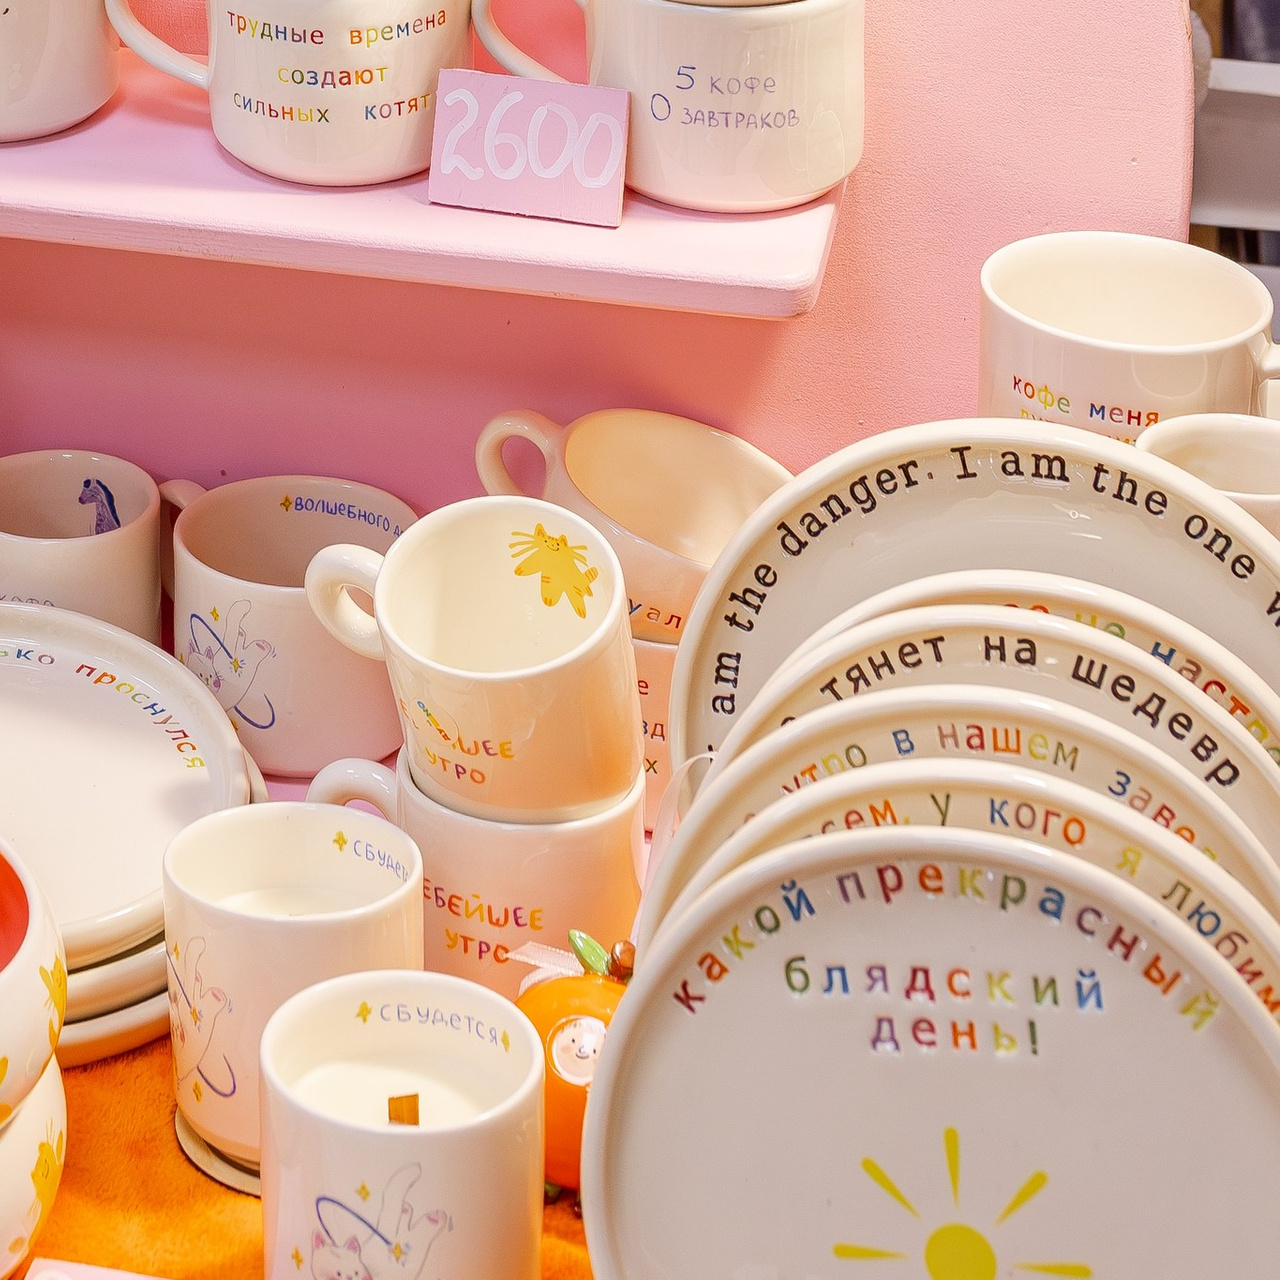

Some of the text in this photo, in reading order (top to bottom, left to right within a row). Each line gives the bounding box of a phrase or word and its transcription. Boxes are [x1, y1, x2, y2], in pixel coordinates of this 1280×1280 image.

[227, 8, 447, 48] трудные времена
[277, 65, 389, 89] создают
[676, 65, 697, 90] 5
[233, 90, 431, 124] сильных котят
[680, 107, 800, 130] ЗАВТРАКОВ
[440, 88, 623, 189] 2600
[1013, 375, 1160, 427] кофе меня
[950, 446, 978, 480] I
[1001, 450, 1070, 482] am
[1092, 462, 1169, 516] the
[776, 459, 934, 557] danger.
[1184, 513, 1256, 580] one
[724, 563, 778, 632] the
[711, 651, 741, 716] am
[75, 663, 208, 771] проснулся
[820, 635, 1240, 787] тянет на шедевр
[425, 746, 486, 784] УТРО
[892, 723, 1079, 772] в нашем
[931, 793, 1143, 877] у кого я
[445, 928, 510, 964] УТРО
[673, 864, 1221, 1032] какой прекрасный
[784, 956, 1105, 1011] блядский
[871, 1016, 1041, 1056] день!
